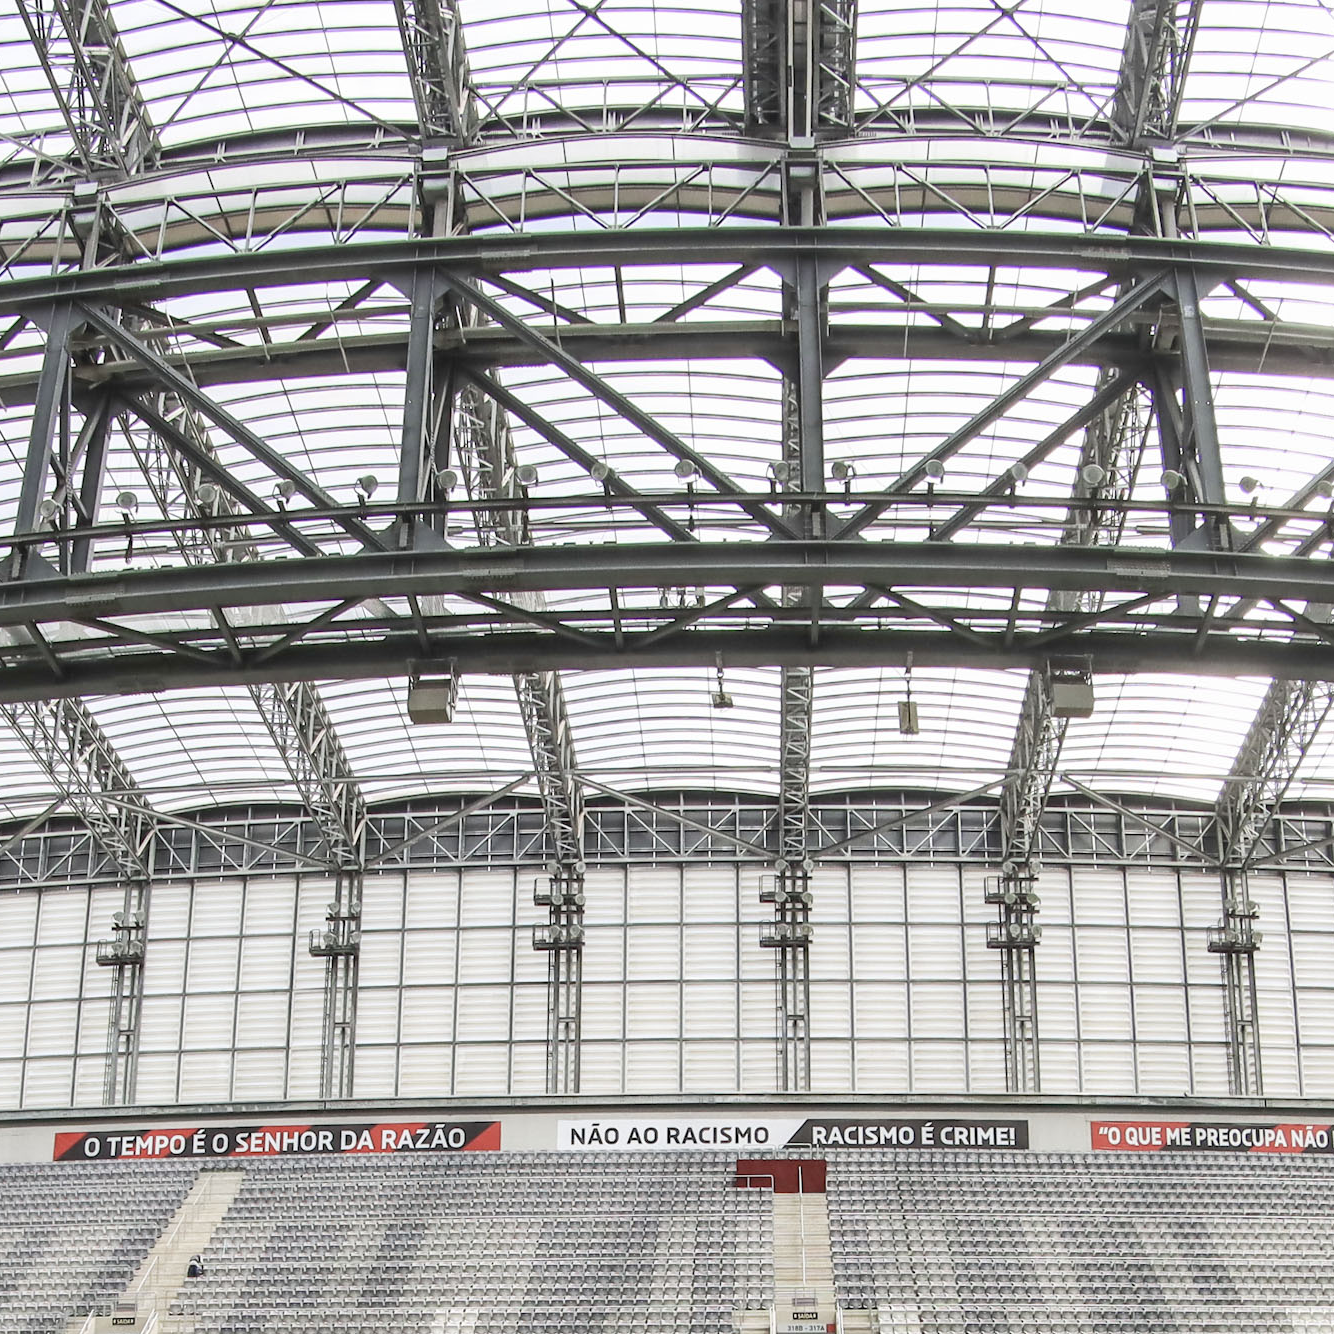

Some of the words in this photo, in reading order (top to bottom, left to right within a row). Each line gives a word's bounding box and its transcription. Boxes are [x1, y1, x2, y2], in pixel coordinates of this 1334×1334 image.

[84, 1139, 100, 1158] O
[106, 1134, 186, 1157] TEMPO
[192, 1130, 205, 1154] É
[212, 1133, 229, 1153] O
[234, 1129, 334, 1153] SENHOR
[340, 1128, 376, 1150] DA
[381, 1124, 466, 1150] RAZÃO
[571, 1122, 619, 1145] NÃO
[626, 1127, 659, 1145] AO
[666, 1126, 769, 1145] RACISMO
[811, 1126, 914, 1146] RACISMO
[921, 1121, 934, 1145] É
[941, 1126, 1016, 1146] CRIME!
[1125, 1127, 1162, 1147] QUE
[1166, 1127, 1191, 1146] ME
[1195, 1127, 1287, 1148] PREOCUPA
[1291, 1125, 1328, 1149] NÃO
